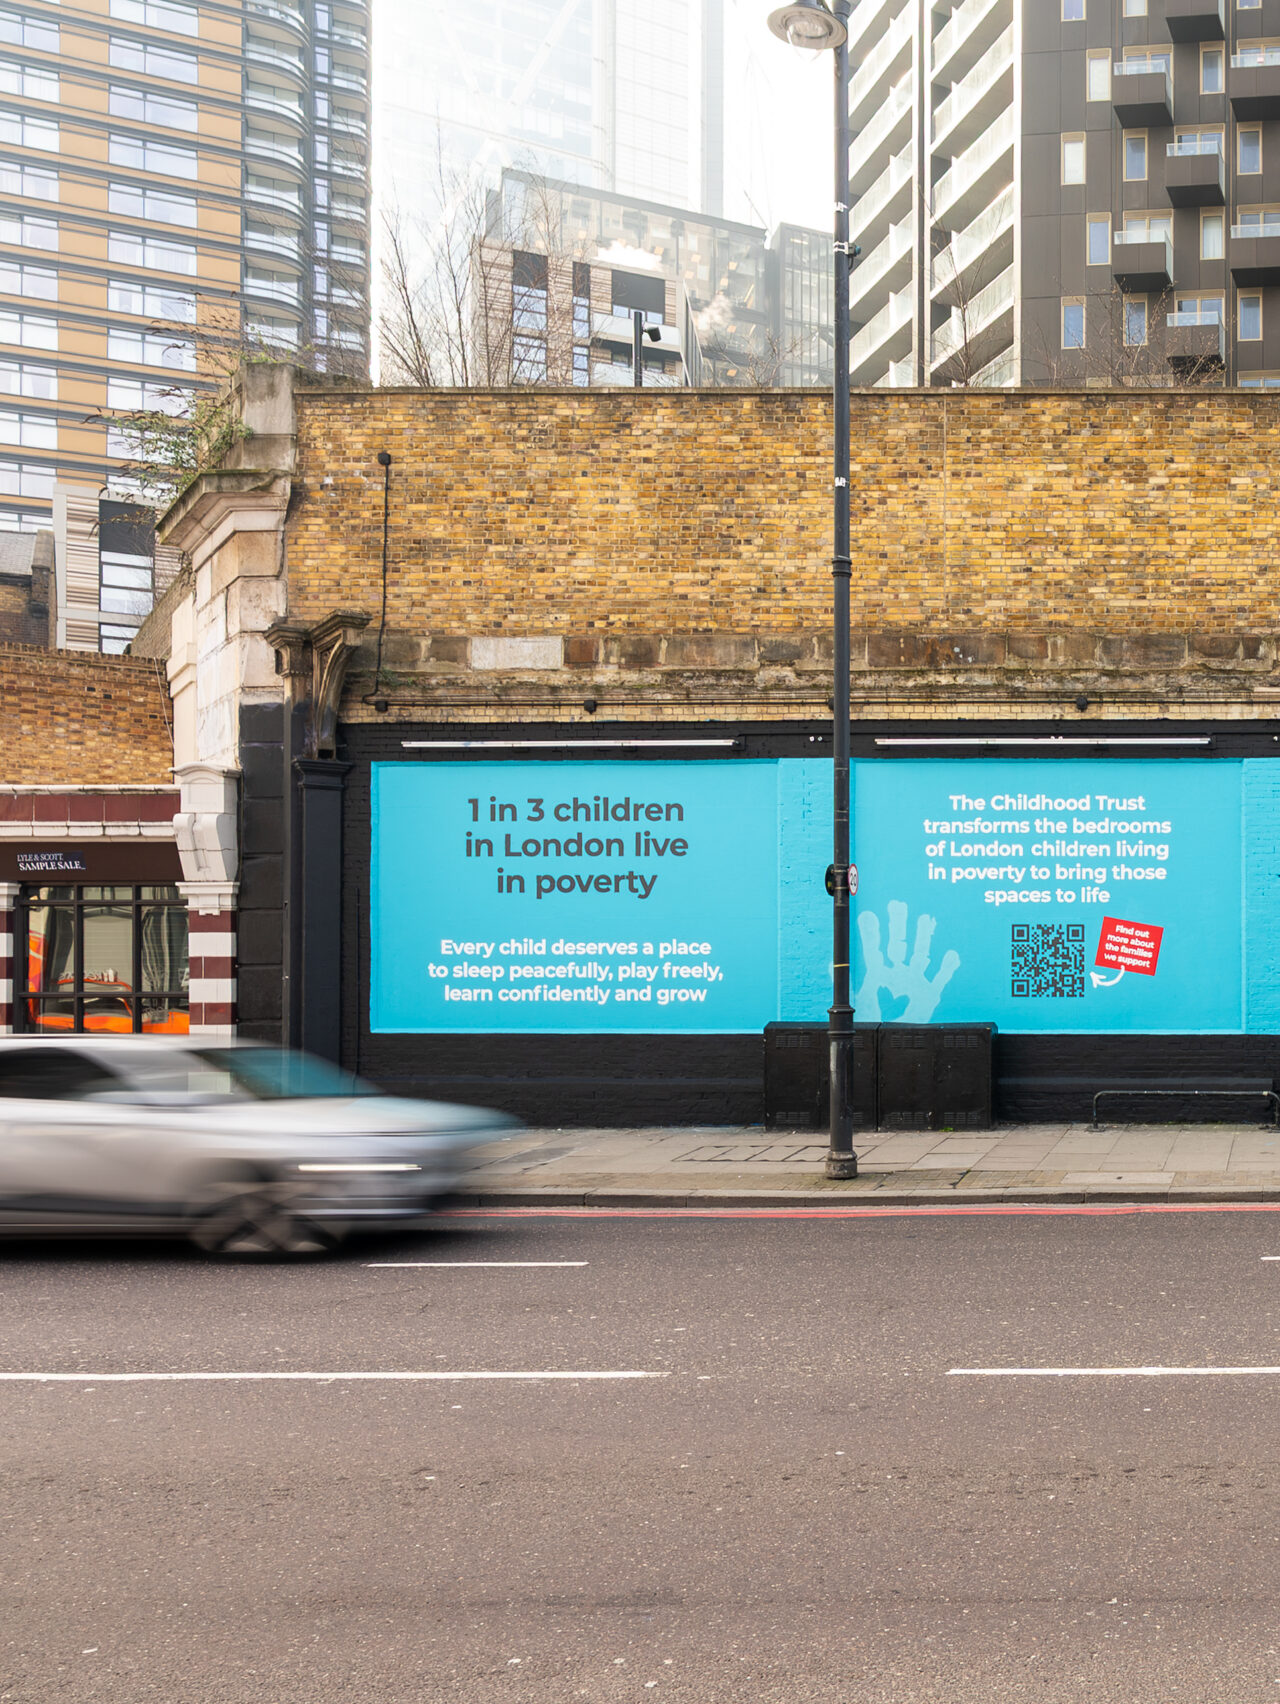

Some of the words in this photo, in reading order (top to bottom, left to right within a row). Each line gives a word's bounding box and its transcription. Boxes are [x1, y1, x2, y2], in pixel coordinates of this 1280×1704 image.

[468, 799, 478, 821] 1
[490, 796, 517, 821] in
[527, 799, 544, 821] 3
[554, 796, 683, 821] children
[949, 795, 985, 810] The
[991, 794, 1090, 810] Childhood
[1095, 796, 1146, 810] Trust
[924, 818, 1030, 833] transforms
[1034, 818, 1067, 833] the
[1073, 818, 1171, 833] bedrooms
[466, 832, 493, 857] in
[505, 832, 624, 857] London
[636, 831, 688, 856] live
[926, 841, 946, 856] of
[951, 841, 1023, 856] London
[1031, 840, 1110, 856] children
[1117, 840, 1168, 860] living
[19, 862, 57, 871] SAMPLE
[929, 863, 946, 879] in
[952, 865, 1026, 883] poverty
[1030, 865, 1050, 879] to
[1056, 863, 1106, 883] bring
[1112, 864, 1167, 879] those
[498, 868, 525, 893] in
[536, 871, 657, 899] poverty
[985, 891, 1051, 906] spaces
[1056, 889, 1076, 902] to
[1081, 886, 1110, 902] life
[1107, 934, 1129, 944] more
[1130, 938, 1154, 948] about
[1116, 925, 1134, 935] Find
[1135, 930, 1149, 938] out
[442, 940, 495, 958] Every
[499, 938, 546, 954] child
[552, 939, 638, 954] deserves
[643, 943, 653, 954] a
[660, 939, 711, 958] place
[1105, 943, 1119, 952] the
[1120, 946, 1153, 958] families
[1104, 953, 1117, 961] we
[1118, 956, 1150, 968] support
[428, 963, 448, 977] to
[453, 962, 504, 981] sleep
[510, 962, 613, 981] peacefully,
[619, 962, 659, 981] play
[663, 962, 723, 981] freely,
[445, 985, 492, 1001] learn
[498, 985, 610, 1004] confidently
[615, 985, 651, 1001] and
[657, 989, 707, 1005] grow
